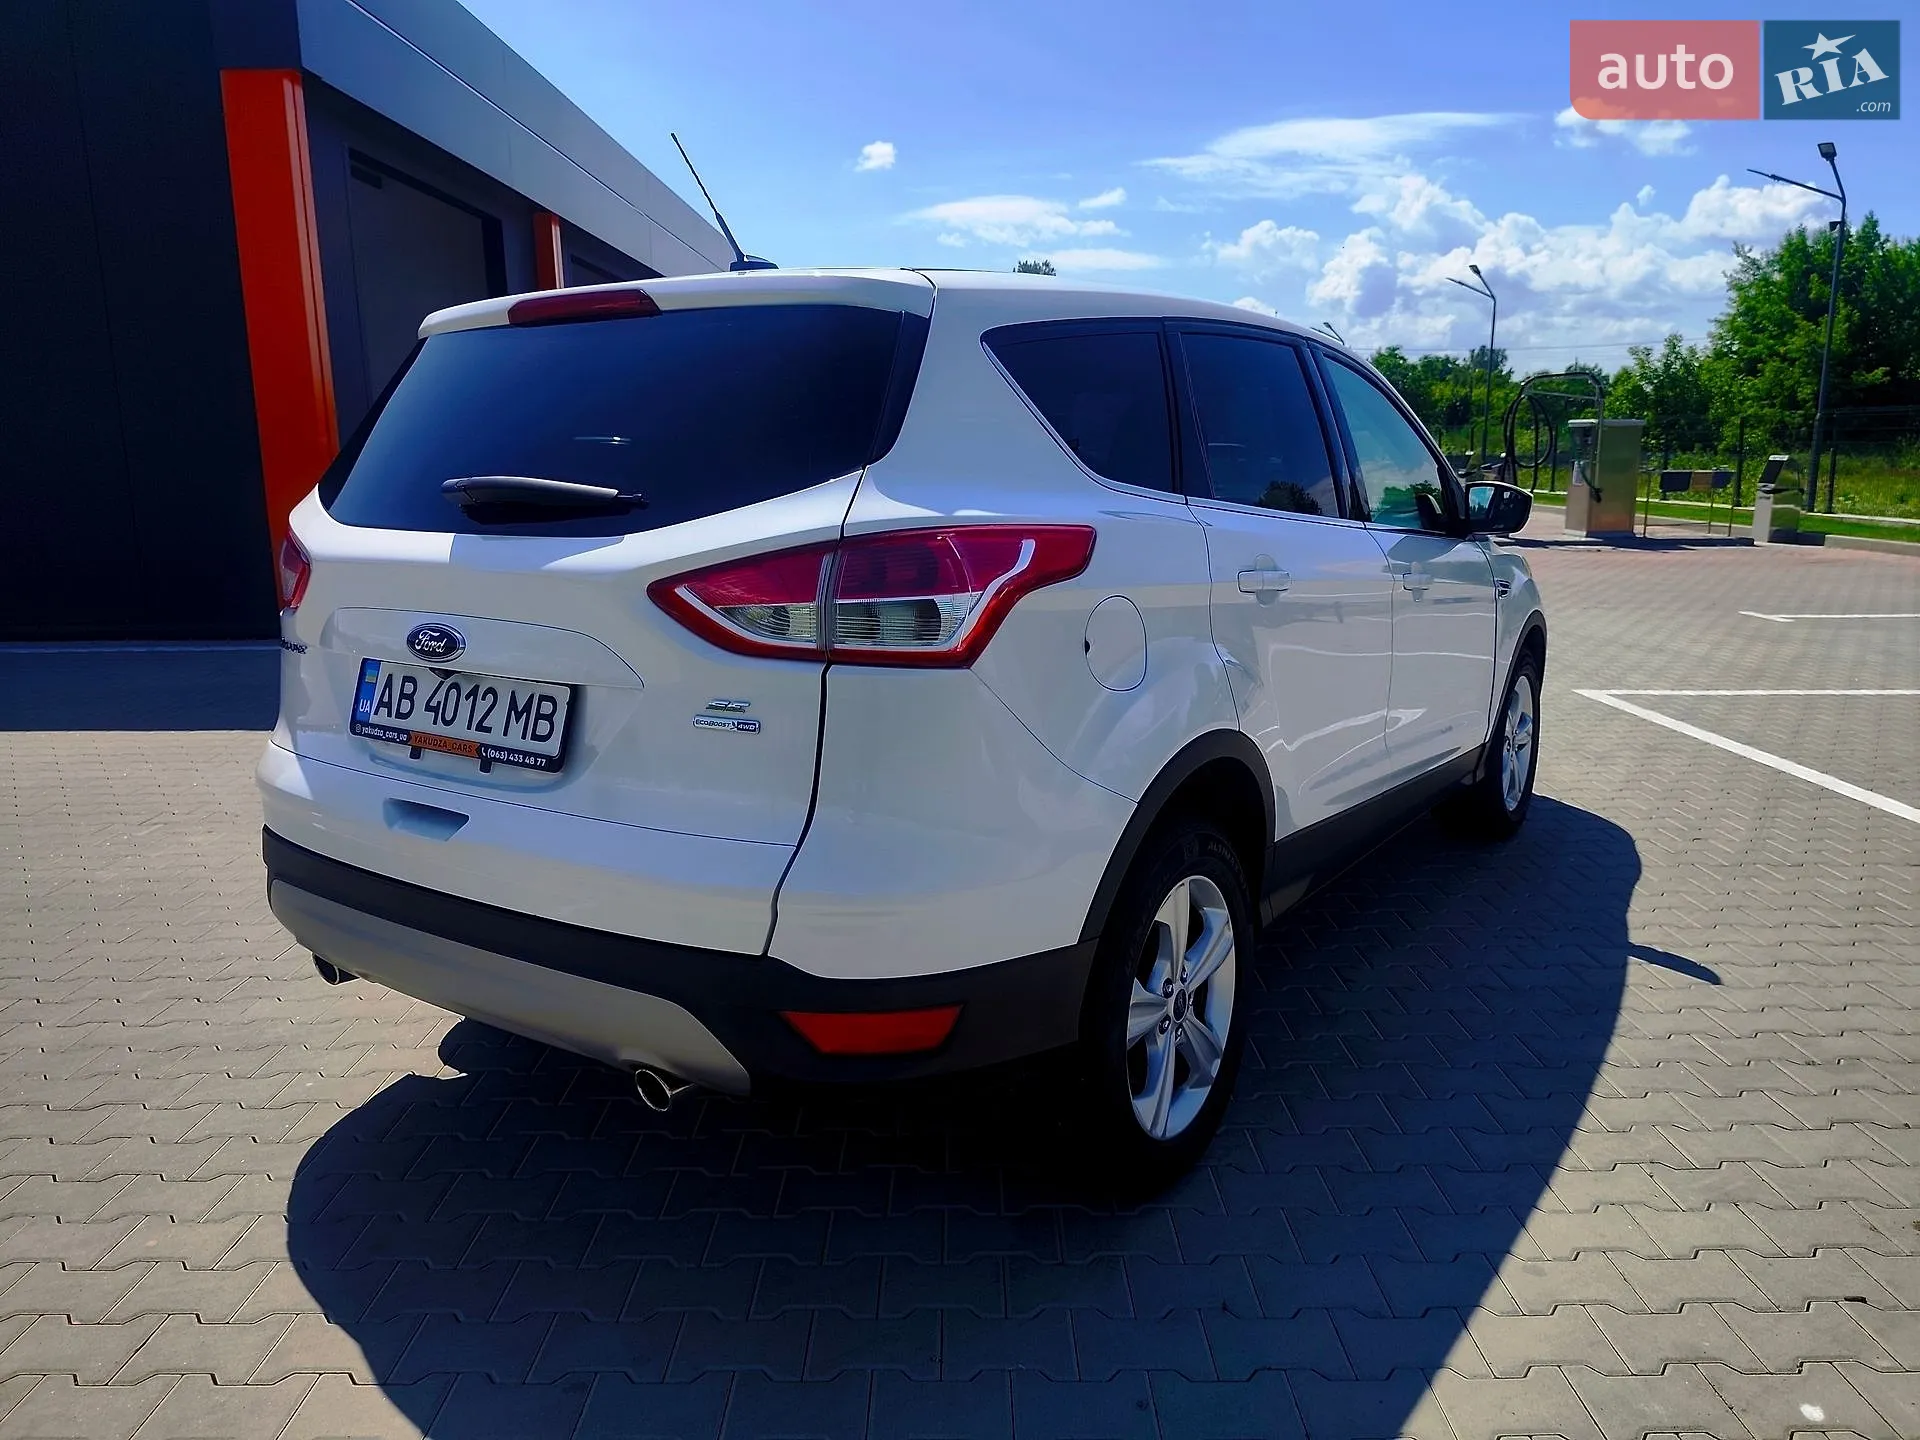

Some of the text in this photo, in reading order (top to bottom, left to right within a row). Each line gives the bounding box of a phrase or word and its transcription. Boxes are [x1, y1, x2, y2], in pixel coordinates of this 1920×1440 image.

[414, 630, 447, 653] Ford
[359, 698, 371, 714] UA
[373, 673, 558, 743] AB 4012 MB
[737, 723, 756, 731] 4WD
[487, 747, 546, 767] (063) 433 48 77
